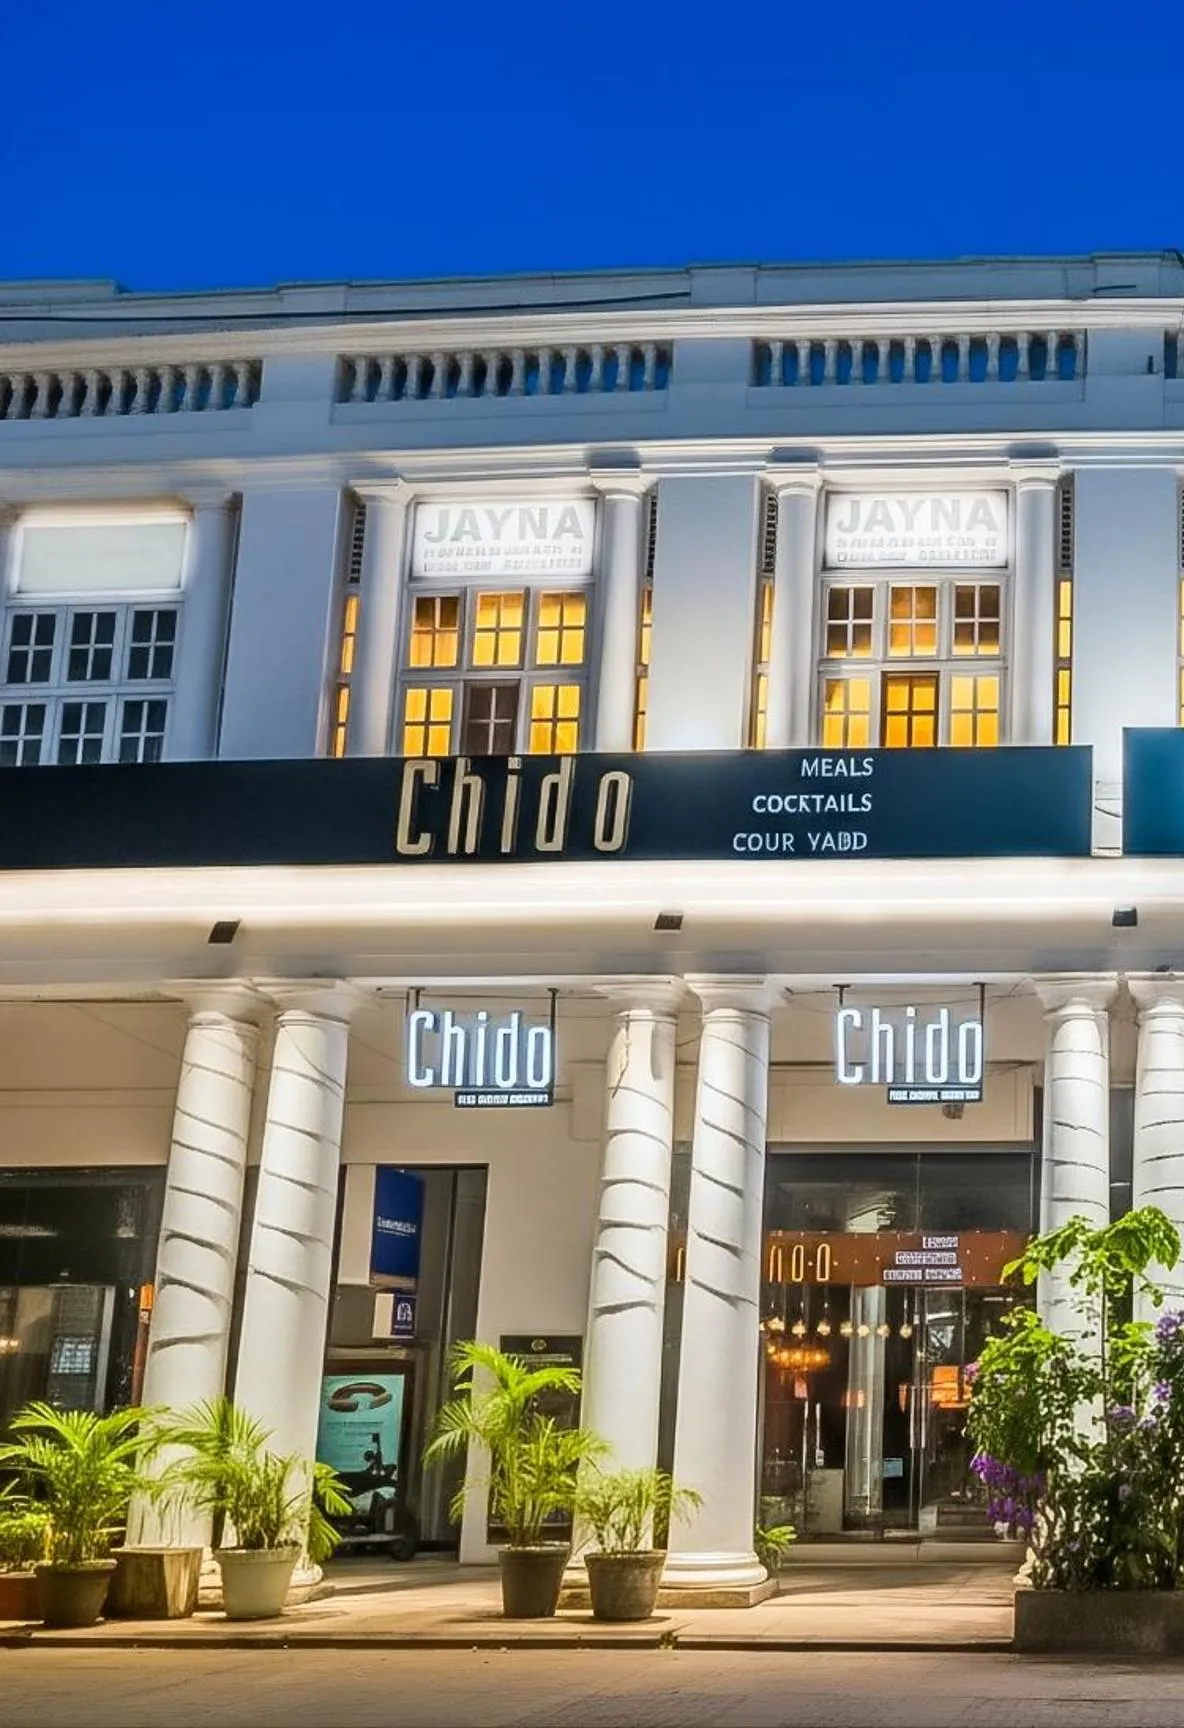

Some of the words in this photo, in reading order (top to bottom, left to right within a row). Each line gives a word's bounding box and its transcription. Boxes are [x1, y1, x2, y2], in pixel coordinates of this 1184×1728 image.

[424, 506, 583, 543] JAYNA
[836, 499, 998, 533] JAYNA
[801, 757, 874, 777] MEALS
[396, 757, 633, 855] Chido
[752, 793, 873, 813] COCKTAILS
[733, 832, 795, 851] COUR
[408, 1010, 551, 1088] Chido
[837, 1006, 982, 1084] Chido
